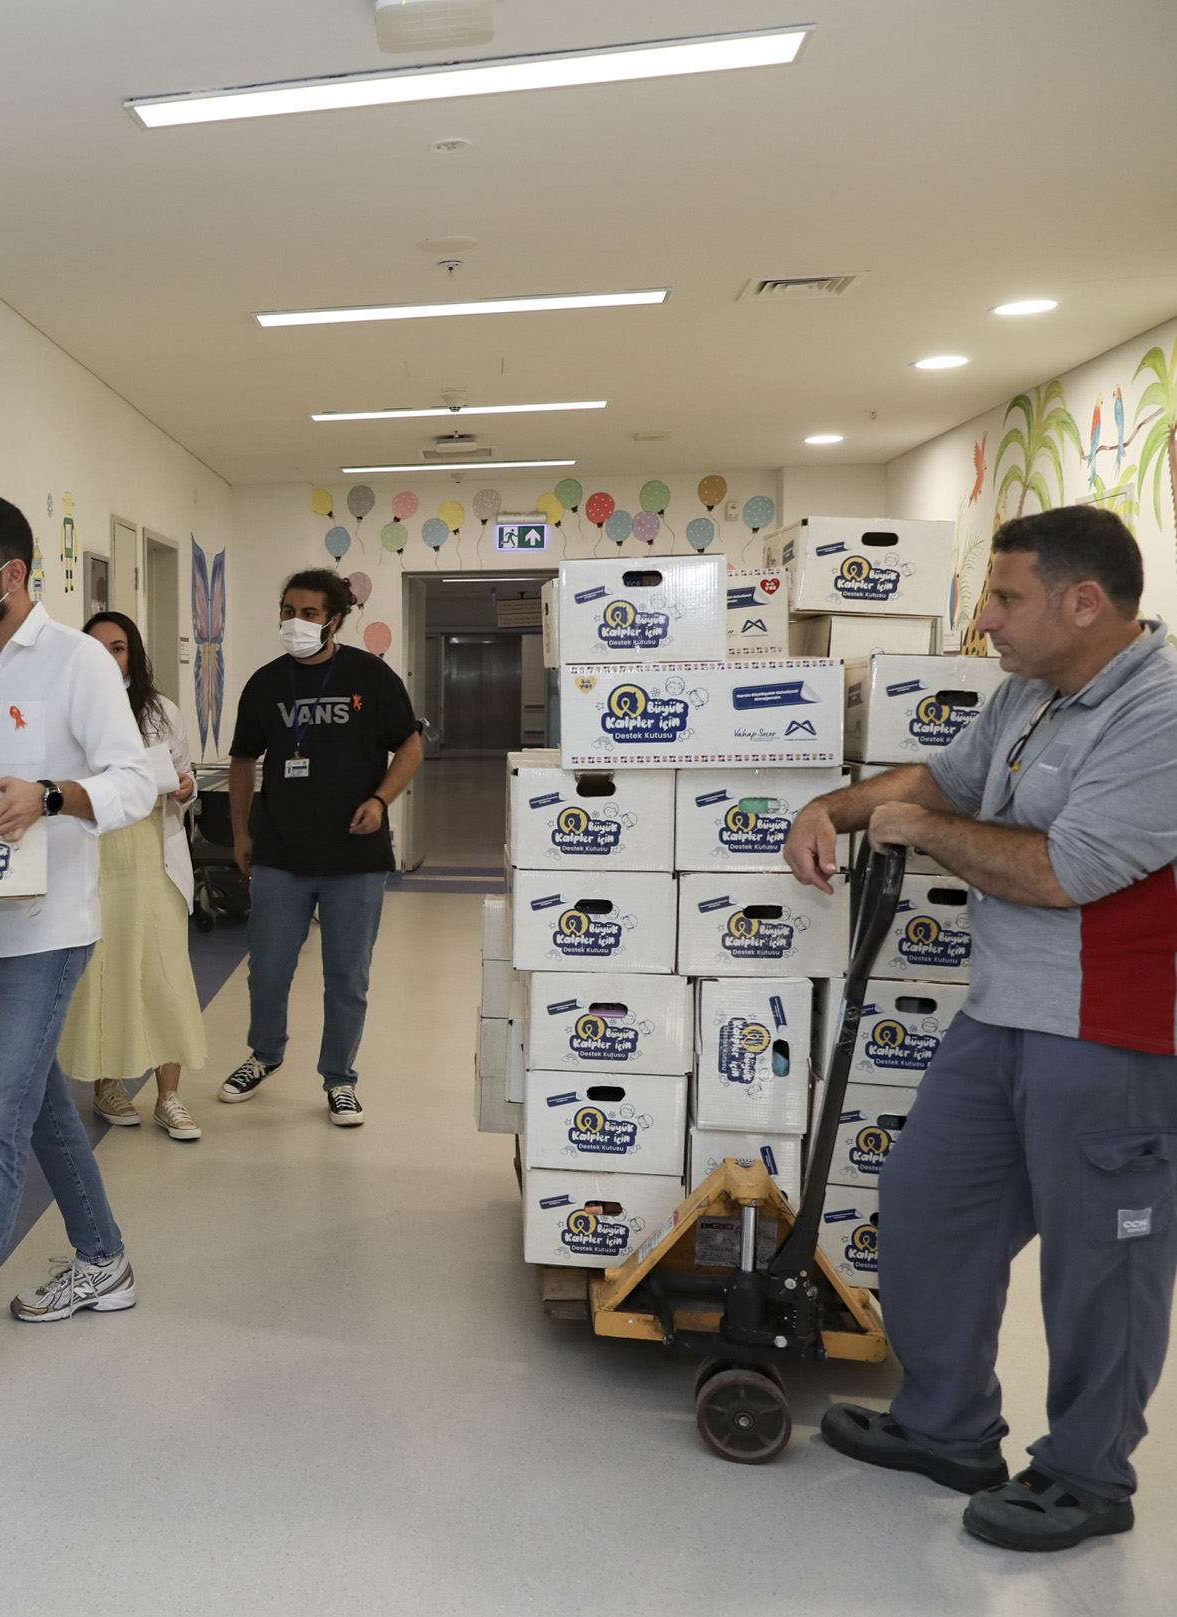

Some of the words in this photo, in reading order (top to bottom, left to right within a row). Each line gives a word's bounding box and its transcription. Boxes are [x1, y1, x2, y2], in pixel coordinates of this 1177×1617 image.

[869, 570, 897, 582] Büyük
[836, 579, 874, 593] Kalpler
[877, 581, 894, 592] için
[635, 613, 667, 628] Büyük
[601, 626, 641, 640] Kalpler
[644, 626, 663, 638] için
[277, 697, 350, 728] VANS
[647, 700, 685, 716] Büyük
[606, 715, 655, 731] Kalpler
[659, 716, 681, 730] için
[950, 710, 978, 724] Büyü
[913, 722, 956, 737] Kalpler
[588, 821, 618, 834] Büyük
[756, 819, 788, 830] Büyük
[555, 832, 594, 845] Kalpler
[597, 834, 615, 846] için
[722, 830, 763, 843] Kalpler
[766, 832, 785, 843] için
[589, 922, 620, 936] Büyük
[760, 925, 790, 938] Büyük
[556, 933, 594, 946] Kalpler
[598, 936, 615, 948] için
[724, 936, 765, 948] Kalpler
[938, 932, 971, 946] Büyük
[902, 941, 944, 954] Kalpler
[948, 944, 966, 956] için
[606, 1028, 636, 1040] Büyük
[572, 1038, 612, 1050] Kalpler
[614, 1040, 632, 1051] için
[904, 1035, 937, 1048] Büyük
[868, 1044, 910, 1058] Kalpler
[914, 1048, 932, 1060] için
[604, 1121, 634, 1134] Büyük
[572, 1130, 610, 1143] Kalpler
[613, 1134, 630, 1145] için
[852, 1150, 886, 1164] Kalpl
[597, 1224, 626, 1236] Büyük
[564, 1232, 604, 1244] Kalpler
[606, 1236, 623, 1247] için
[848, 1248, 878, 1262] Kalpl
